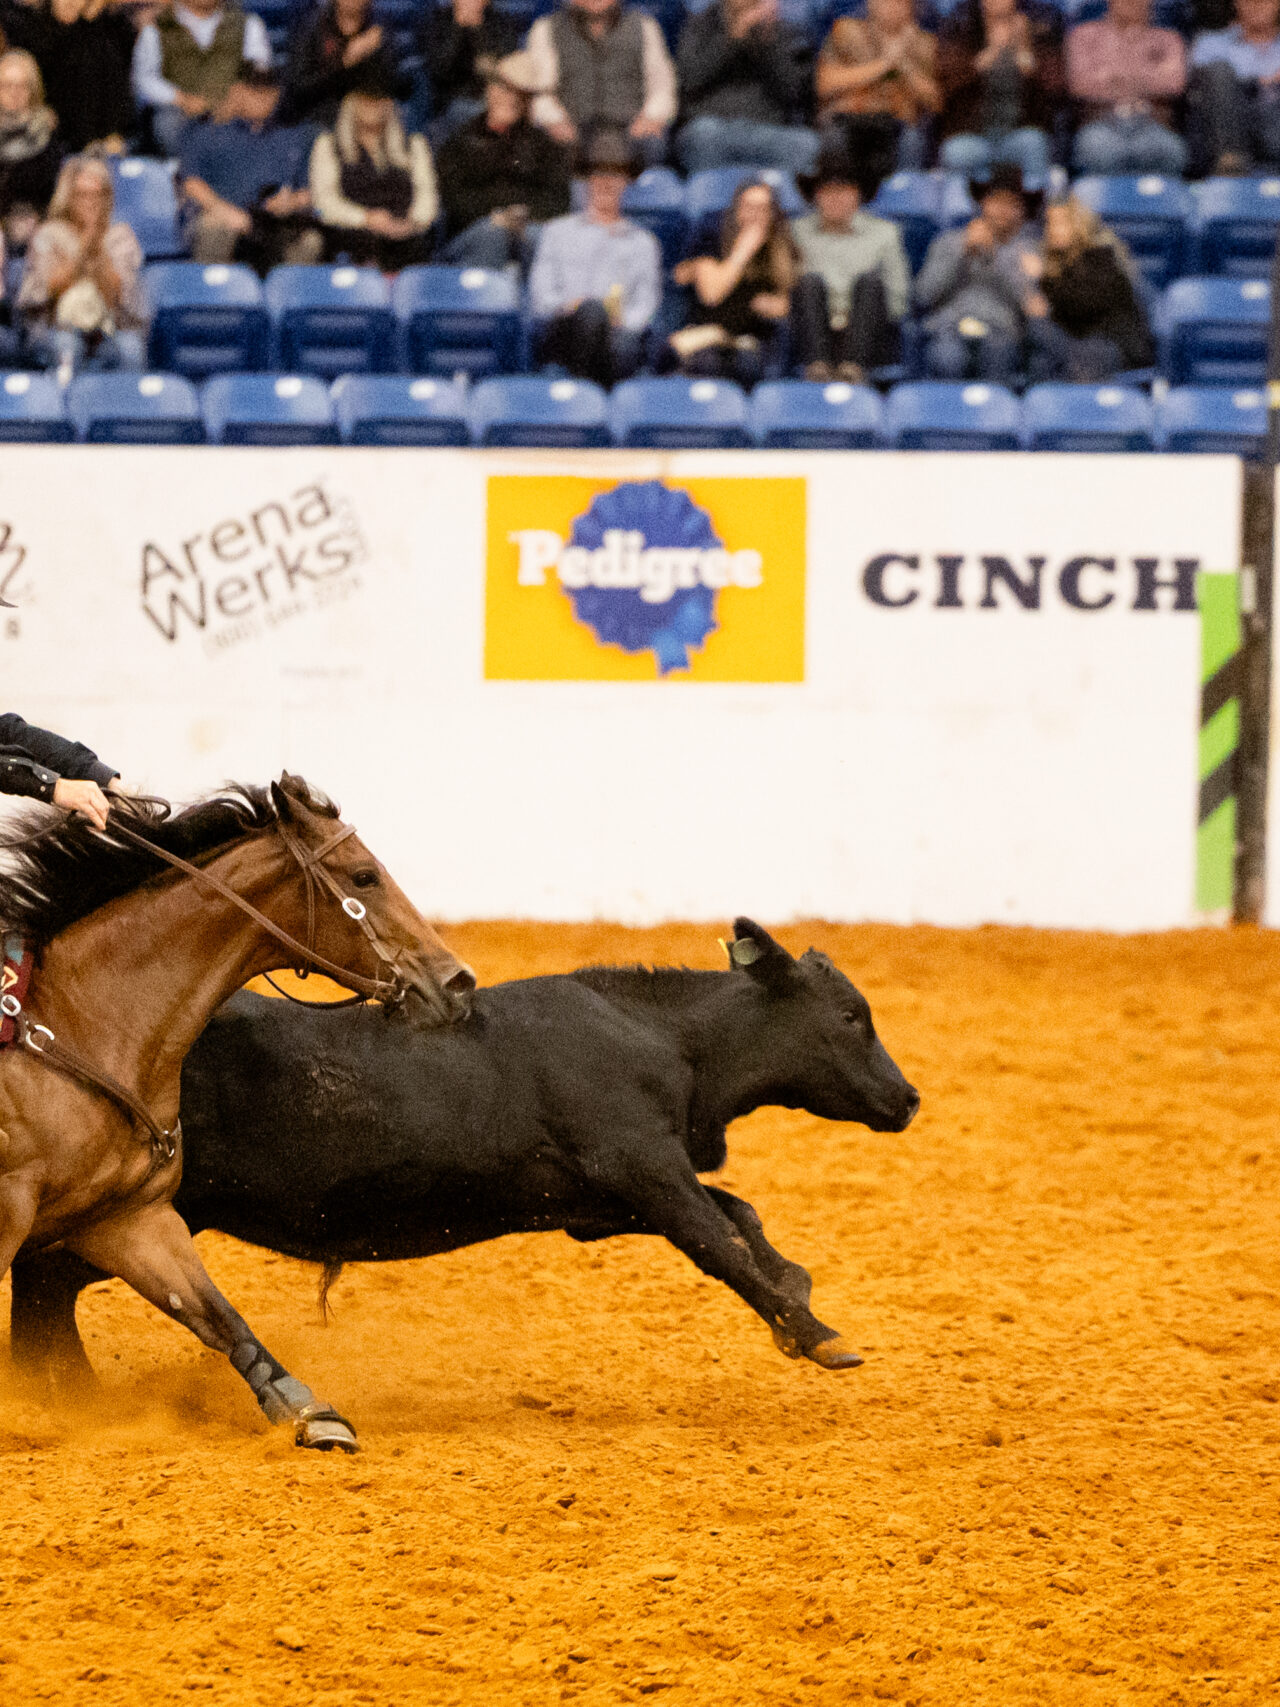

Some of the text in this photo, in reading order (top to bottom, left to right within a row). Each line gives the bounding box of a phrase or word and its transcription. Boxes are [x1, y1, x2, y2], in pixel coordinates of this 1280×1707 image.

[140, 484, 331, 597] Arena
[141, 530, 353, 643] Werks
[506, 528, 763, 603] Pedigree
[862, 552, 1200, 611] CINCH
